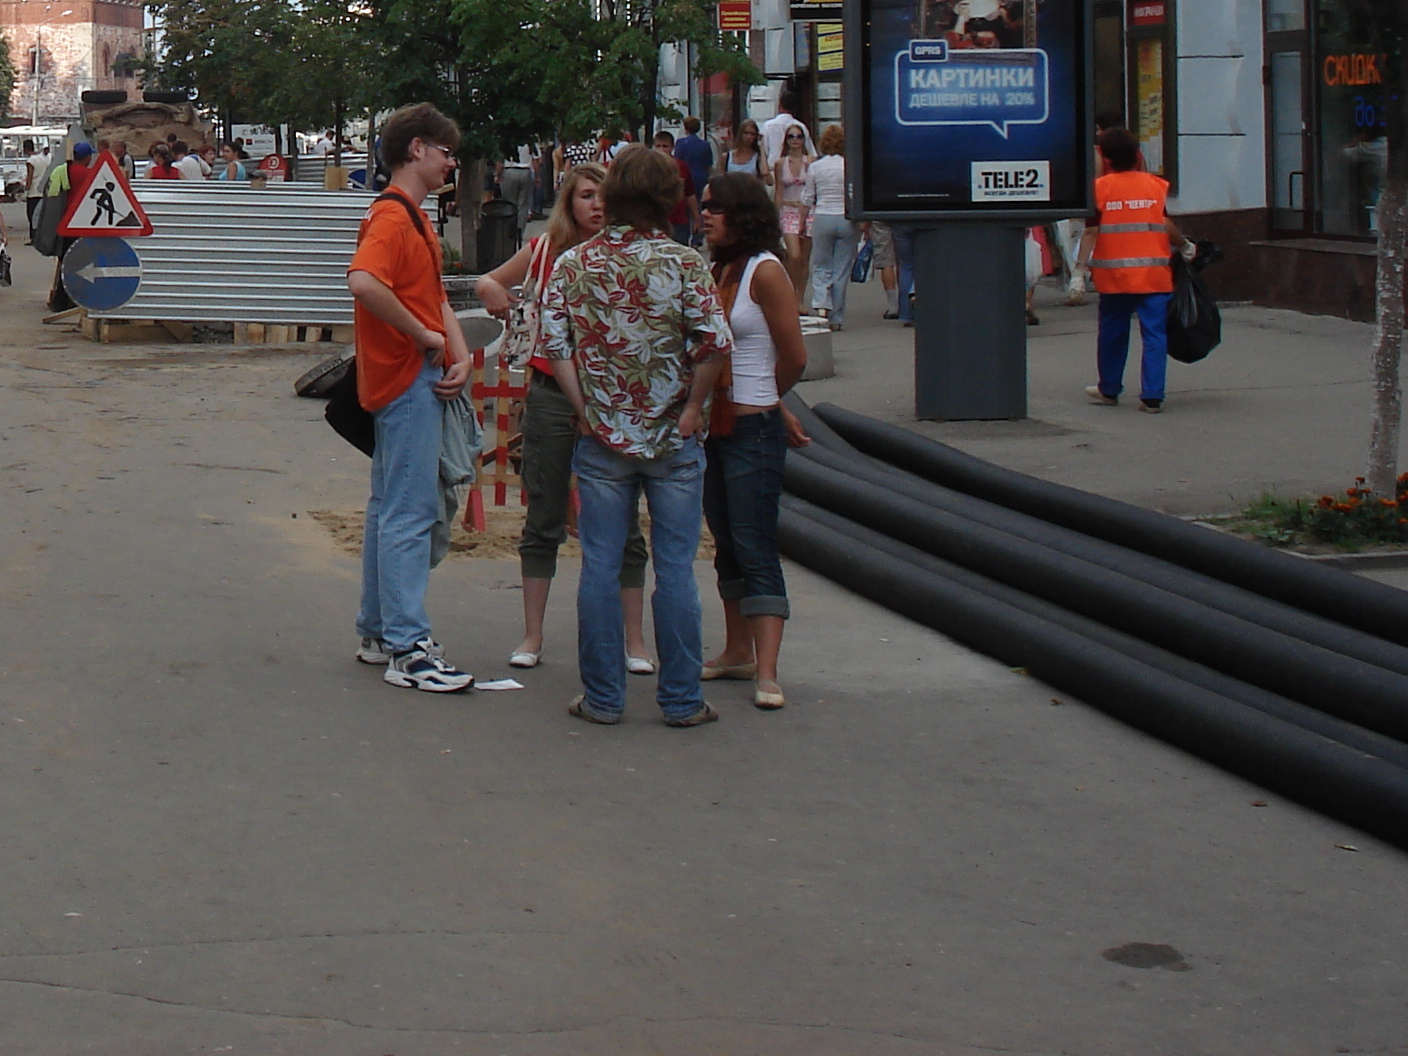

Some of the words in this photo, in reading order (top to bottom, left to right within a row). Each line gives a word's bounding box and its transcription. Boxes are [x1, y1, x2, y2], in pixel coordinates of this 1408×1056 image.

[915, 46, 941, 56] GPRS
[910, 68, 1035, 89] КАРТИНКИ
[1323, 54, 1389, 86] СКИДК
[909, 92, 978, 108] ДЕШЕВЛЕ
[981, 93, 1000, 106] НА
[1005, 93, 1036, 106] 20%
[981, 169, 1040, 189] TELE2
